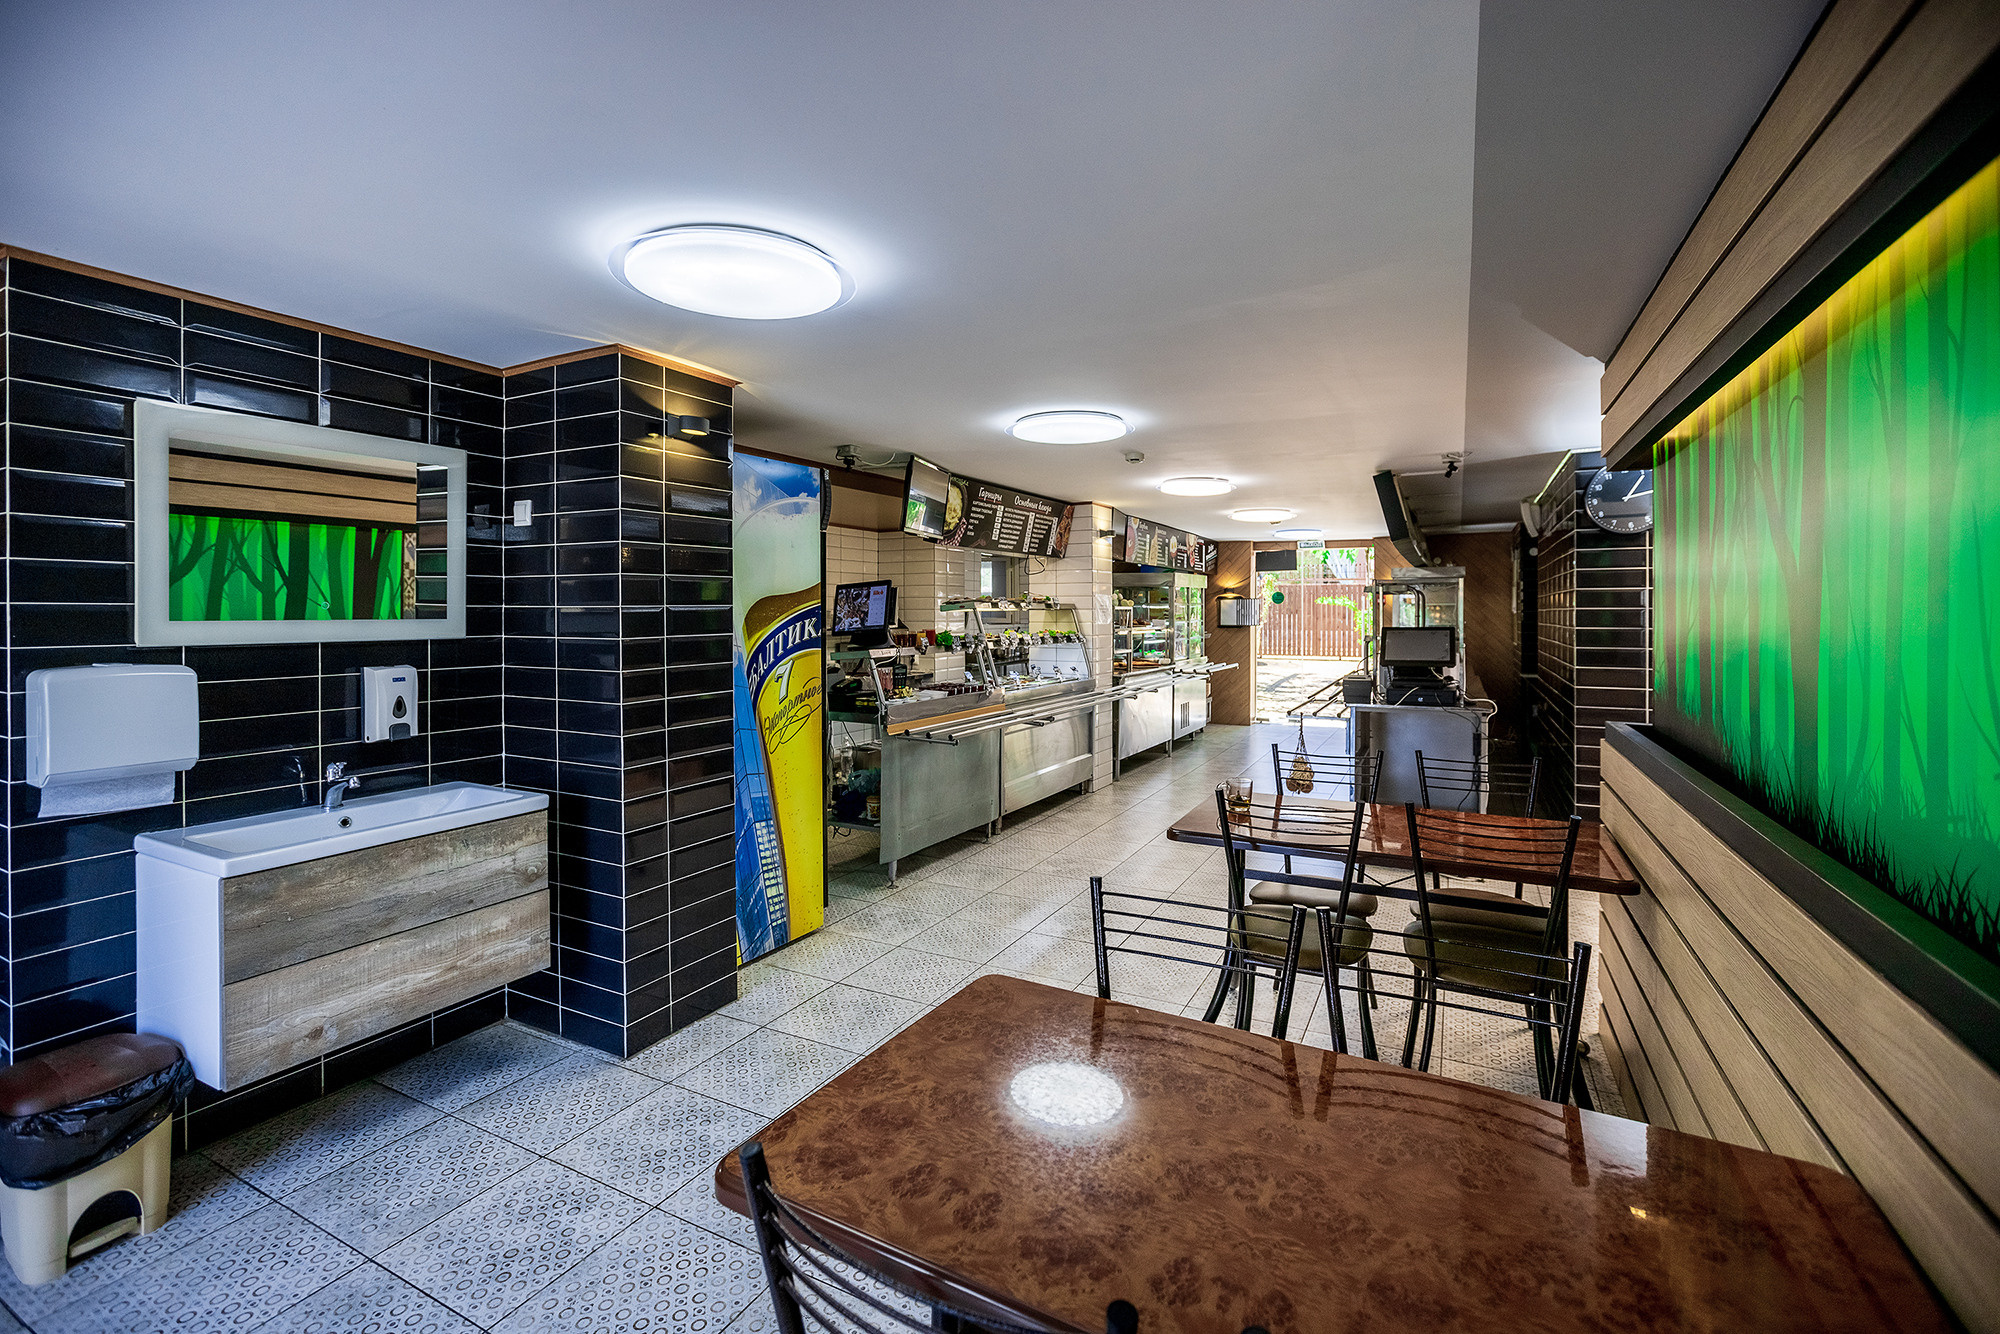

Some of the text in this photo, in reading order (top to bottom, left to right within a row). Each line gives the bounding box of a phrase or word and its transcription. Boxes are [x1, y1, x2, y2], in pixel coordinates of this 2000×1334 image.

[1628, 521, 1634, 529] 6
[1645, 515, 1652, 523] 5
[749, 617, 821, 692] БАЛТИК
[774, 659, 795, 705] 7
